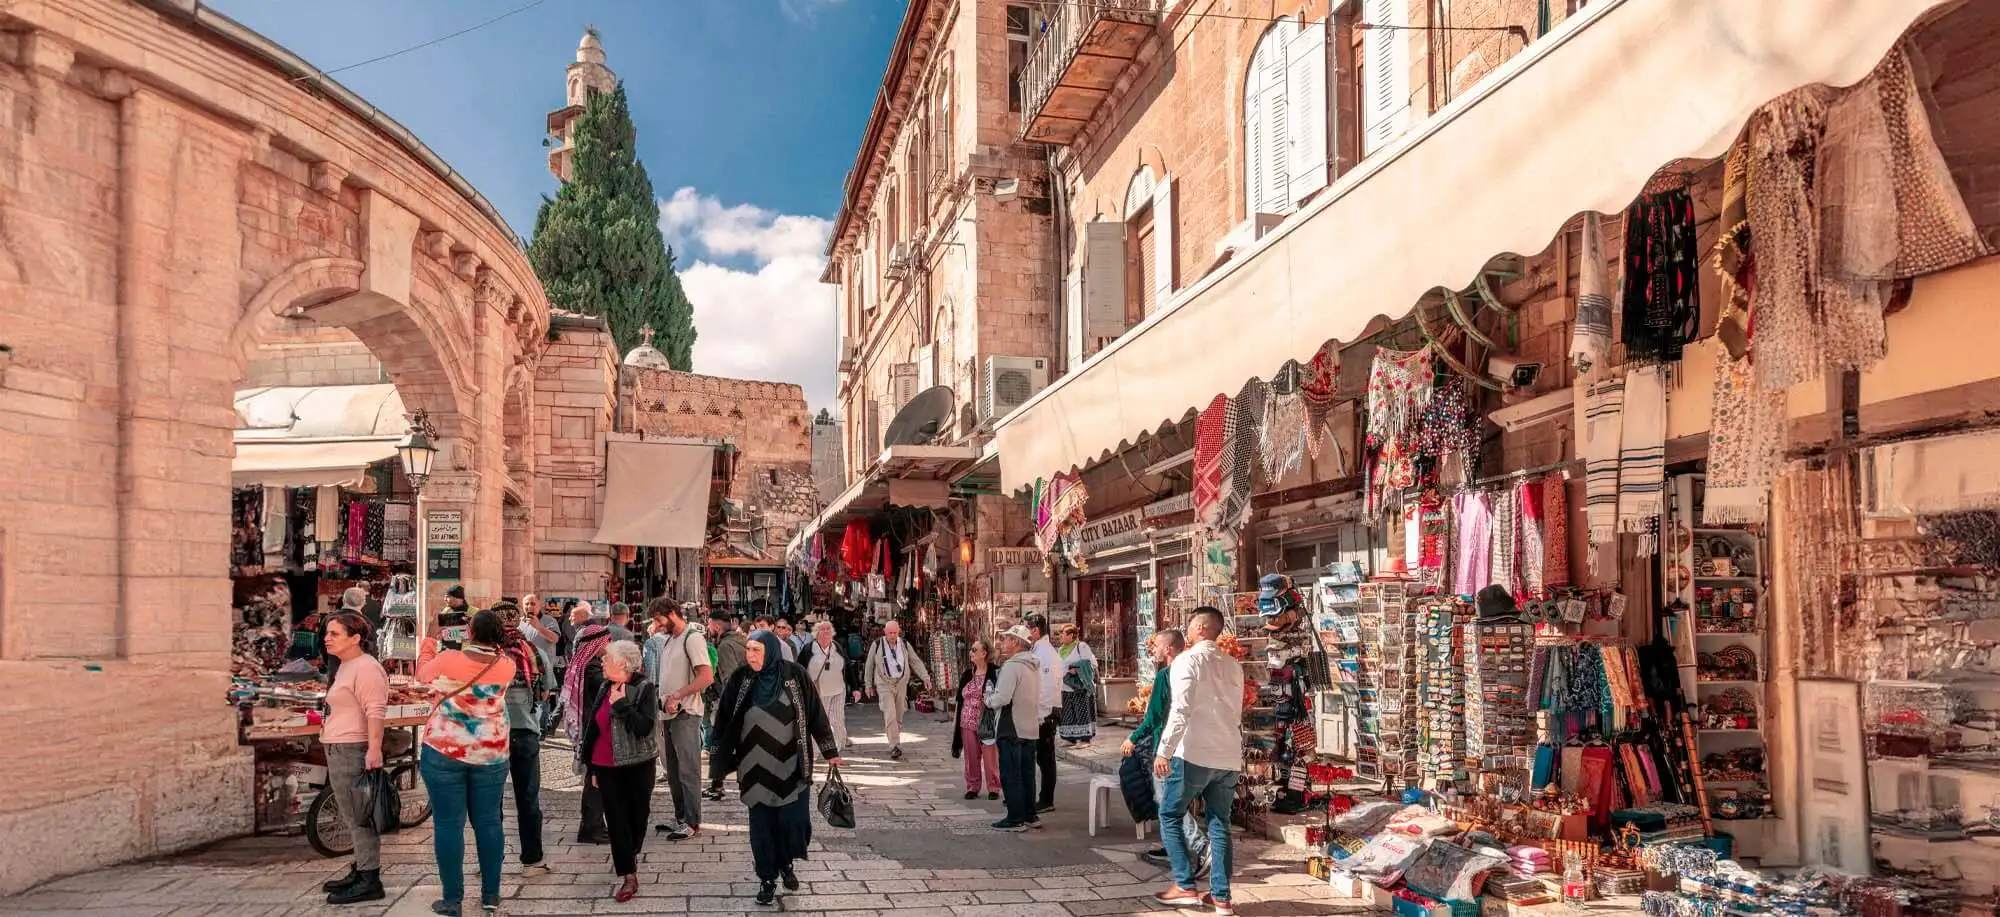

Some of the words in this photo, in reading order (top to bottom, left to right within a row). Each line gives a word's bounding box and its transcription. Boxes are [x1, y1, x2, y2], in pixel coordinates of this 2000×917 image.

[1081, 526, 1100, 543] CITY
[1102, 514, 1138, 537] BAZAAR
[1006, 551, 1021, 564] CITY
